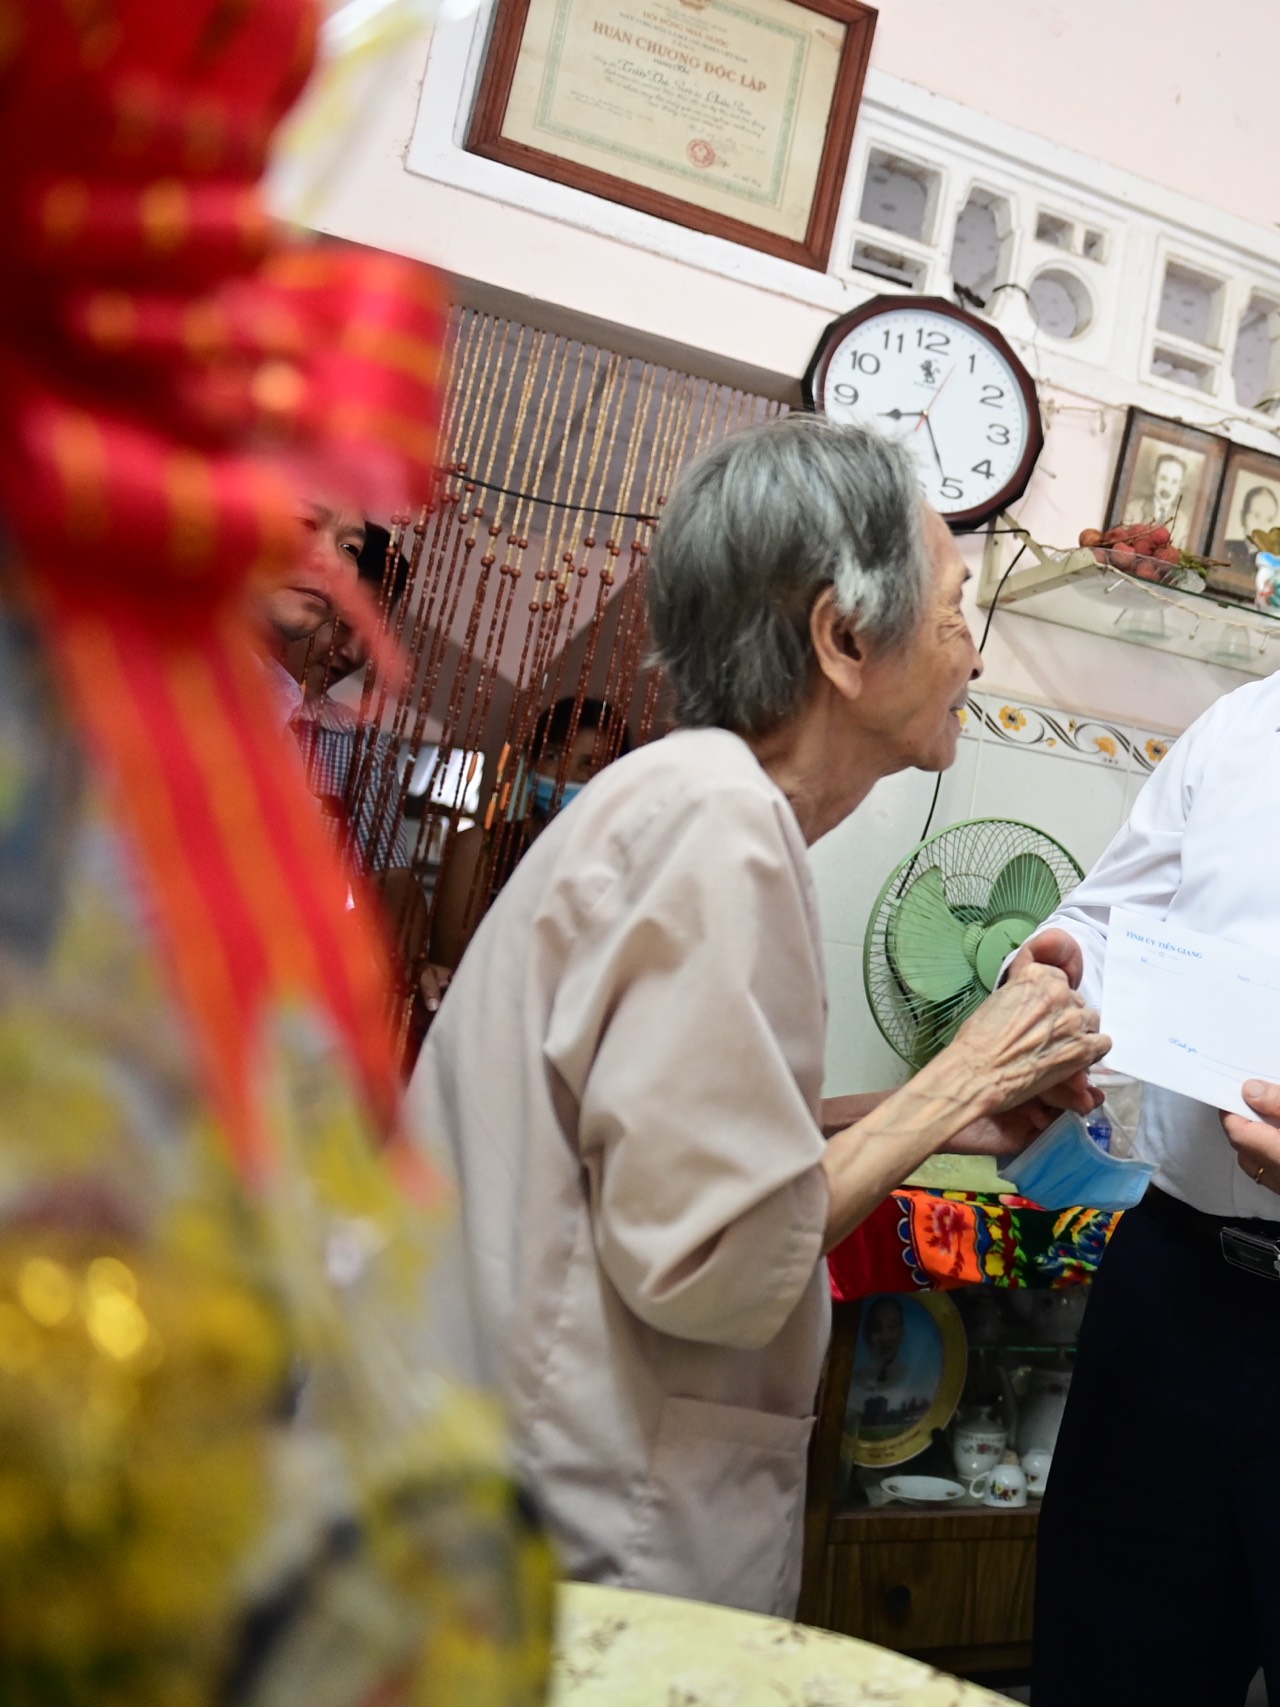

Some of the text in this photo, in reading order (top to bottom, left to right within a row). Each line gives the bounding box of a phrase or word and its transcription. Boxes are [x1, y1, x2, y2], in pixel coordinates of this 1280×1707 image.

[883, 329, 904, 353] 11
[916, 328, 950, 356] 12
[851, 350, 881, 375] 10
[968, 354, 976, 374] 1
[833, 383, 859, 406] 9
[979, 384, 1005, 409] 2
[986, 423, 1010, 446] 3
[971, 459, 995, 480] 4
[939, 477, 964, 500] 5
[1177, 947, 1203, 959] GIANG
